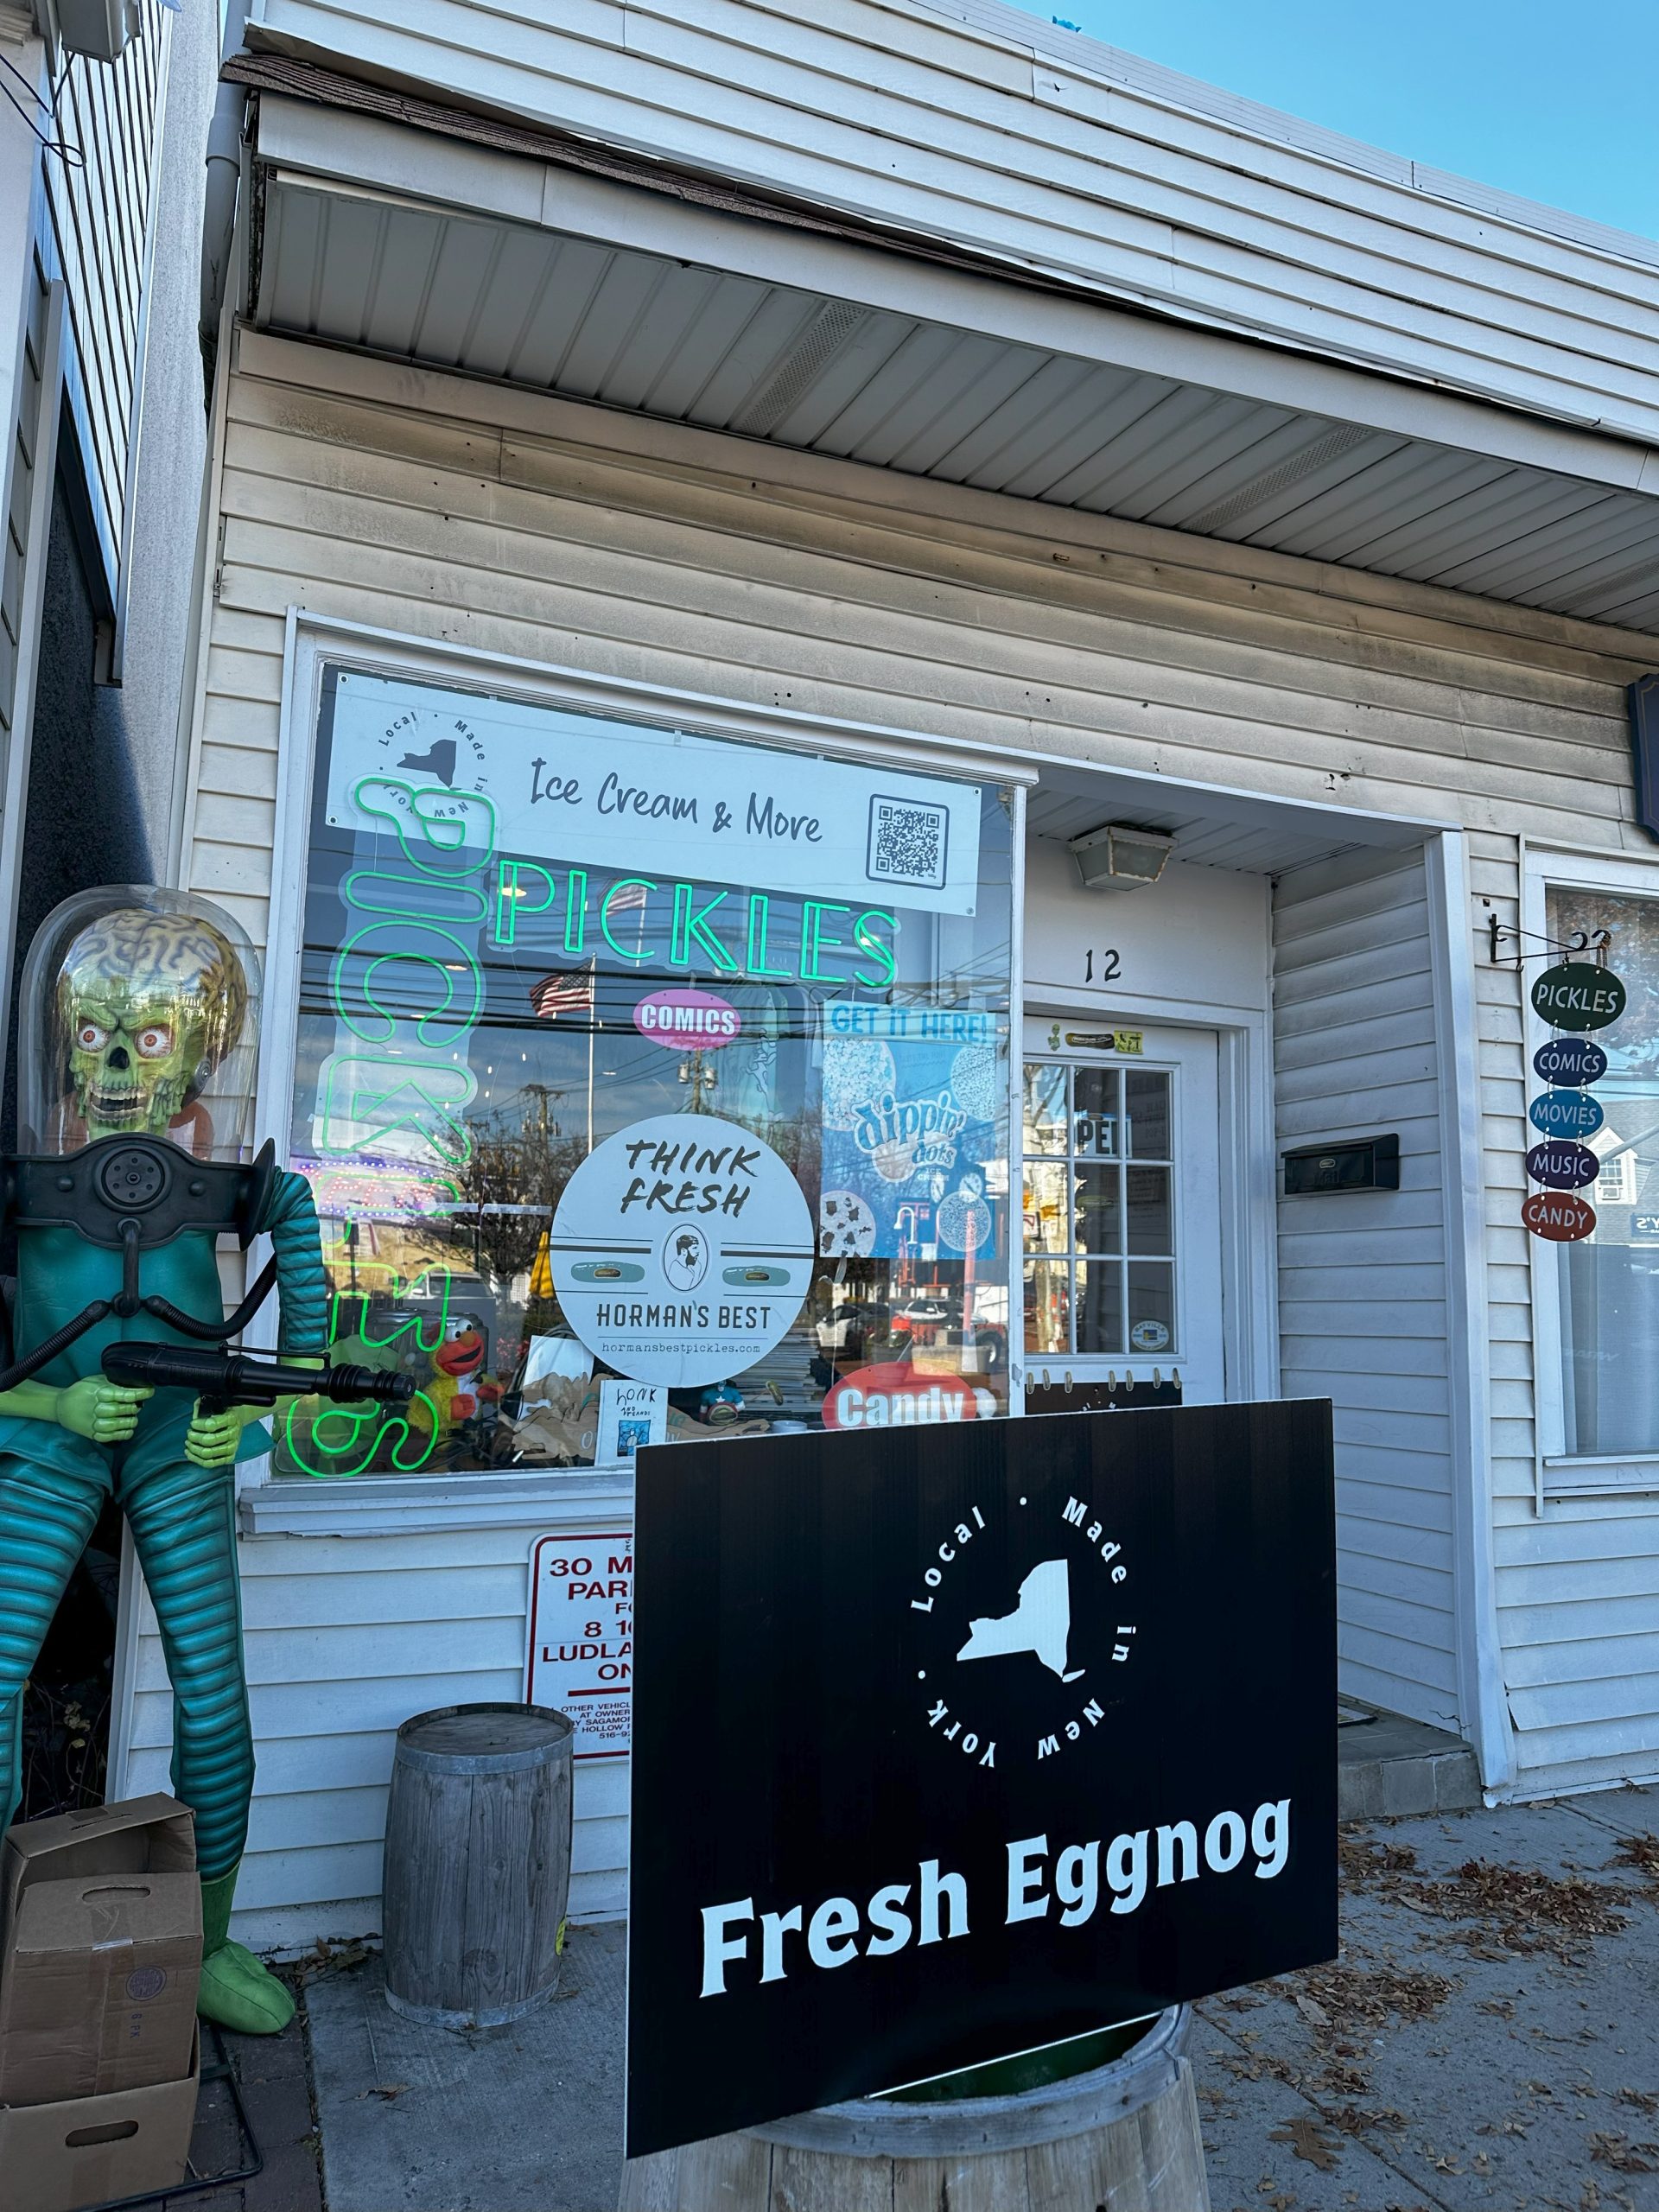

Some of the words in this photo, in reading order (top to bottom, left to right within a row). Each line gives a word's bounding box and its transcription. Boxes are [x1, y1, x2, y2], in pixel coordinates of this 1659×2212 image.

[378, 711, 416, 747] Local
[454, 719, 486, 761] Made
[383, 783, 417, 815] Yor
[474, 776, 488, 792] in
[531, 757, 582, 804] Ice
[597, 772, 698, 823] Cream
[712, 801, 733, 833] &
[747, 792, 823, 842] More
[434, 801, 470, 818] New
[495, 860, 899, 987] PICKLES
[1085, 949, 1122, 982] 12
[1536, 983, 1618, 1014] PICKLES
[642, 1004, 735, 1035] COMICS
[831, 1005, 879, 1034] GET
[921, 1012, 987, 1044] HERE!
[1539, 1052, 1600, 1073] COMICS
[1534, 1104, 1597, 1126] MOVIES
[626, 1140, 760, 1177] THINK
[912, 1140, 953, 1164] dots
[1533, 1154, 1590, 1177] MUSIC
[620, 1178, 750, 1217] FRESH
[1529, 1205, 1588, 1230] CANDY
[596, 1300, 709, 1328] HORMAN'S
[719, 1306, 771, 1329] BEST
[602, 1342, 760, 1354] hormansbestpickles.com
[837, 1388, 964, 1427] Candy
[1062, 1496, 1127, 1584] Made
[550, 1558, 592, 1577] 30
[911, 1506, 986, 1613] Local
[568, 1580, 632, 1600] PAR
[584, 1622, 602, 1637] 8
[1111, 1625, 1136, 1662] in
[543, 1641, 632, 1662] LUDLA
[561, 1704, 594, 1713] OTHER
[586, 1716, 630, 1726] SAGAMO
[582, 1725, 623, 1733] HOLLOW
[927, 1699, 996, 1768] York
[1038, 1698, 1105, 1760] New
[700, 1859, 970, 1998] Fresh
[1005, 1798, 1291, 1927] Eggnog
[130, 2025, 141, 2038] PK
